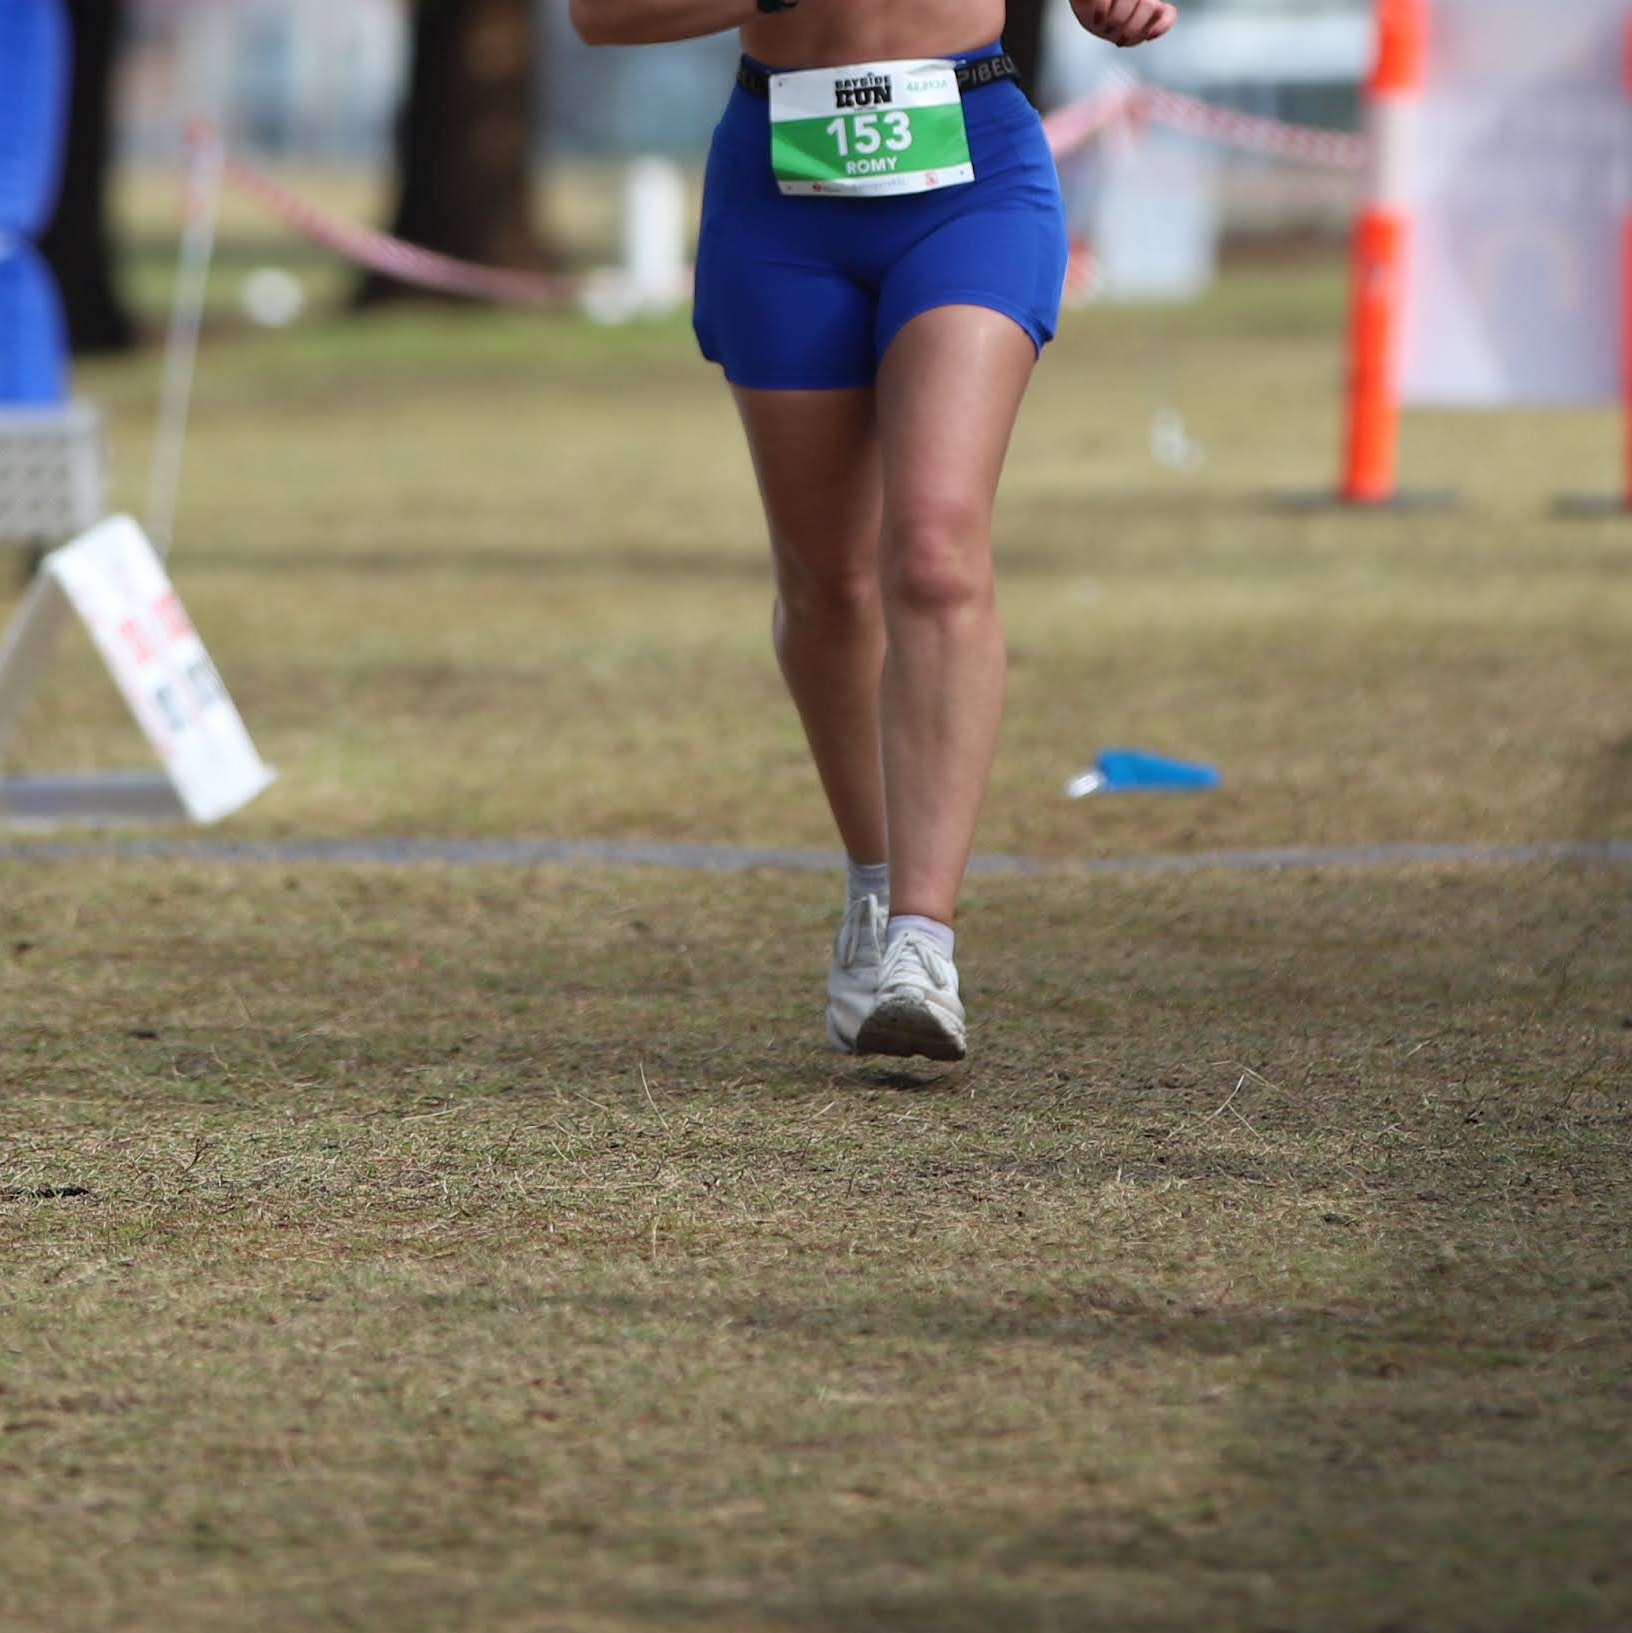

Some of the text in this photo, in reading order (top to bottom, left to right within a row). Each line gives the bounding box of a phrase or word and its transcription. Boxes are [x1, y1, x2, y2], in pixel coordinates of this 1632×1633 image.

[834, 73, 892, 89] BAYSIDE
[834, 85, 894, 109] RUN
[826, 111, 914, 158] 153
[845, 156, 898, 176] ROMY
